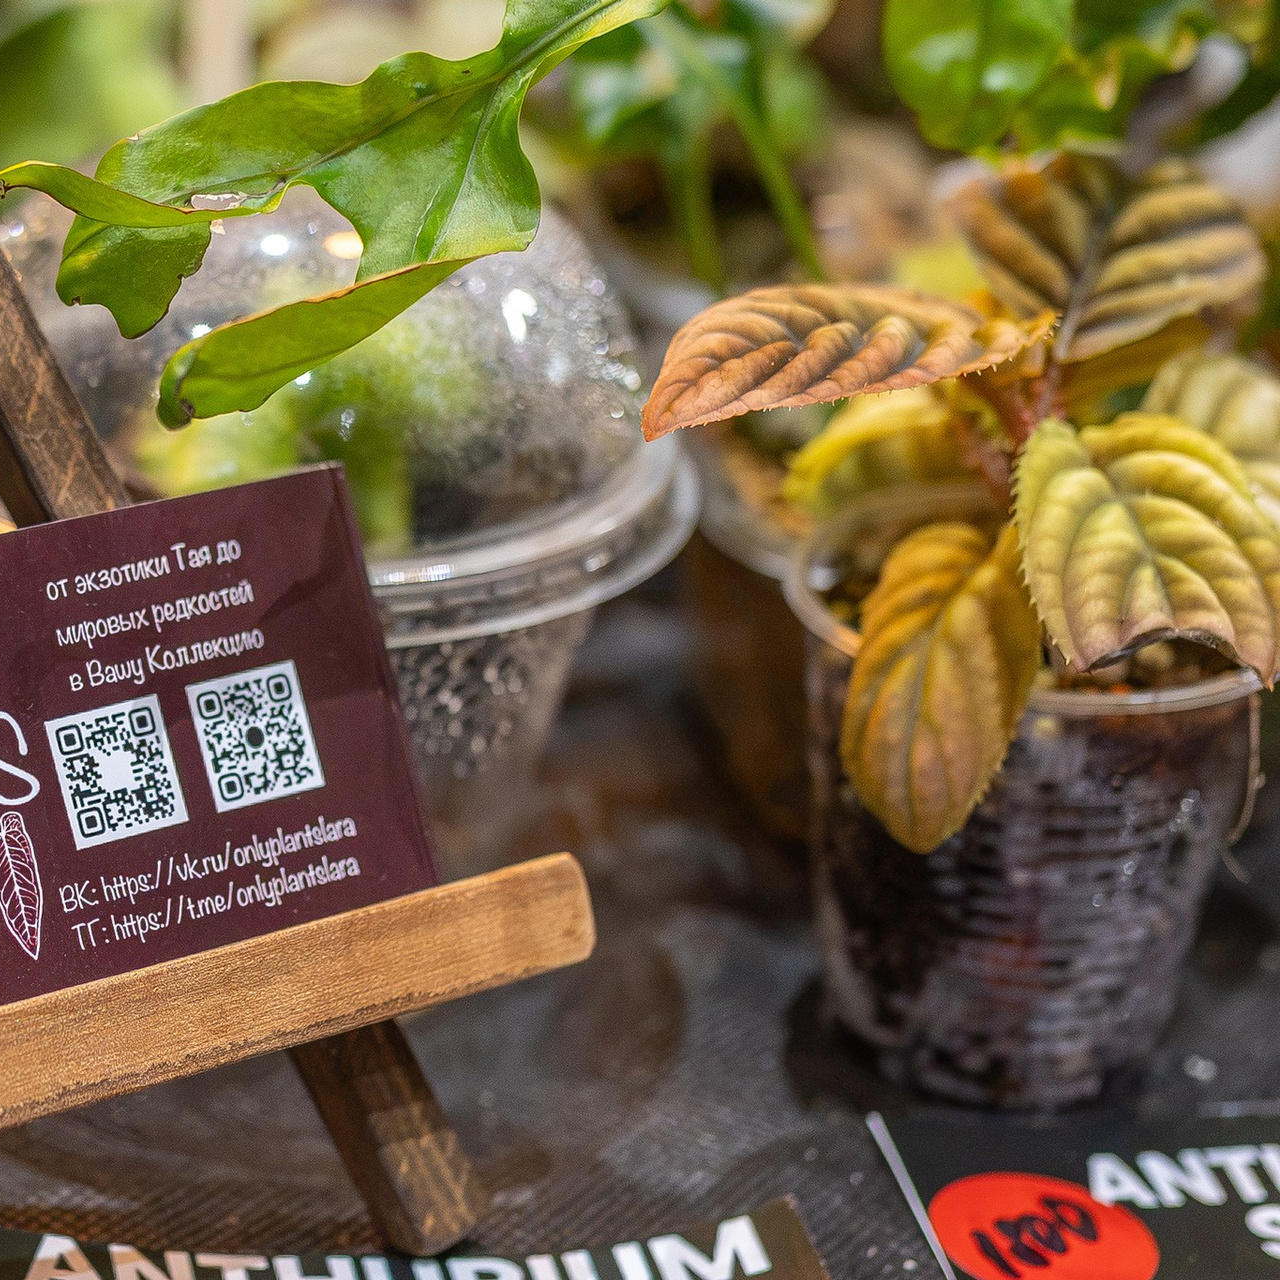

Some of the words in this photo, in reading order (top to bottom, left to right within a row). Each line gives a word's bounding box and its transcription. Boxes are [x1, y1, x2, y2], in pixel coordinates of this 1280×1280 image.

[46, 578, 69, 601] от
[75, 554, 171, 595] экзотики
[170, 542, 212, 571] Тая
[216, 539, 242, 565] до
[56, 608, 150, 649] мировых
[151, 579, 255, 633] редкостей
[69, 672, 83, 692] в
[85, 659, 144, 685] Вашу
[145, 628, 265, 674] Коллекцию
